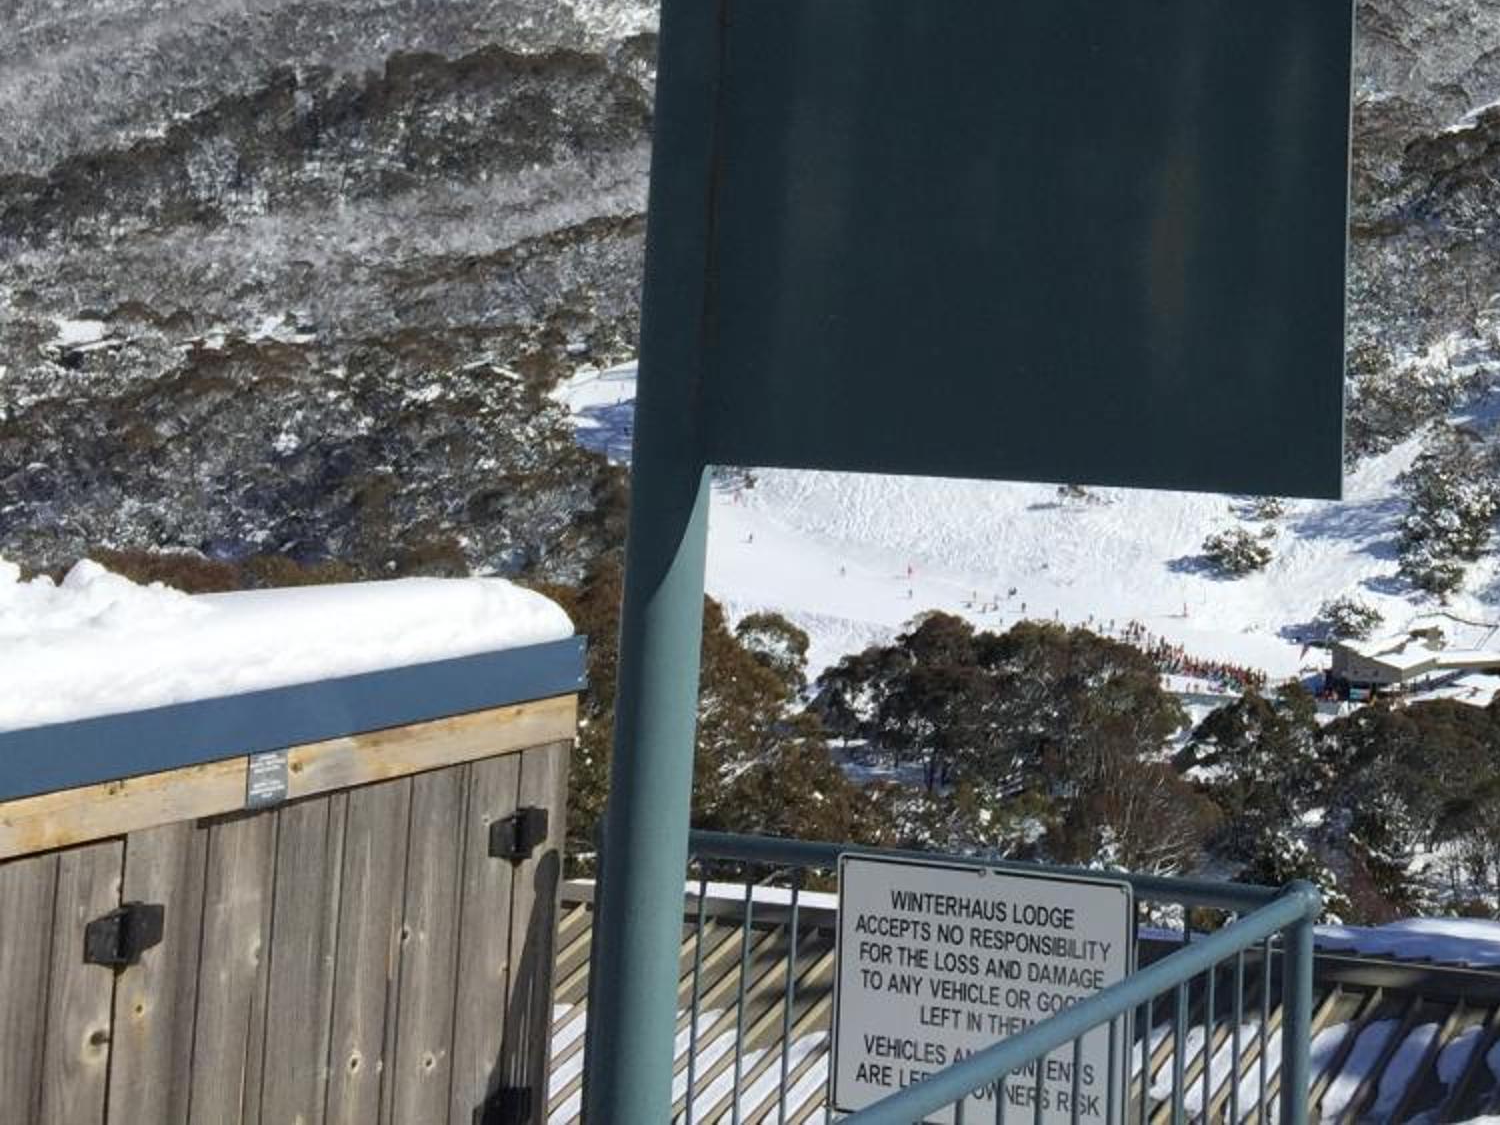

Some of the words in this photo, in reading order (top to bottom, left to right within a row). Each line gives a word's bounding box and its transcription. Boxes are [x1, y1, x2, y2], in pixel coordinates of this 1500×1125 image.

[891, 890, 1007, 922] WINTERHAUS
[1013, 902, 1075, 930] LODGE
[856, 914, 931, 942] ACCEPTS
[937, 923, 964, 946] NO
[970, 927, 1111, 962] RESPONSIBILITY
[860, 941, 892, 964] FOR
[897, 946, 928, 969] THE
[935, 951, 979, 976] LOSS
[986, 957, 1021, 980] AND
[1028, 961, 1105, 990] DAMAGE
[861, 968, 883, 990] TO
[888, 973, 923, 997] ANY
[930, 978, 1000, 1006] VEHICLE
[1005, 988, 1030, 1011] OR
[1037, 992, 1087, 1012] GOO
[920, 1005, 961, 1030] LEFT
[967, 1011, 982, 1032] IN
[864, 1034, 947, 1065] VEHICLES
[856, 1062, 892, 1087] ARE
[899, 1069, 932, 1088] LE
[1056, 1091, 1100, 1116] RSK
